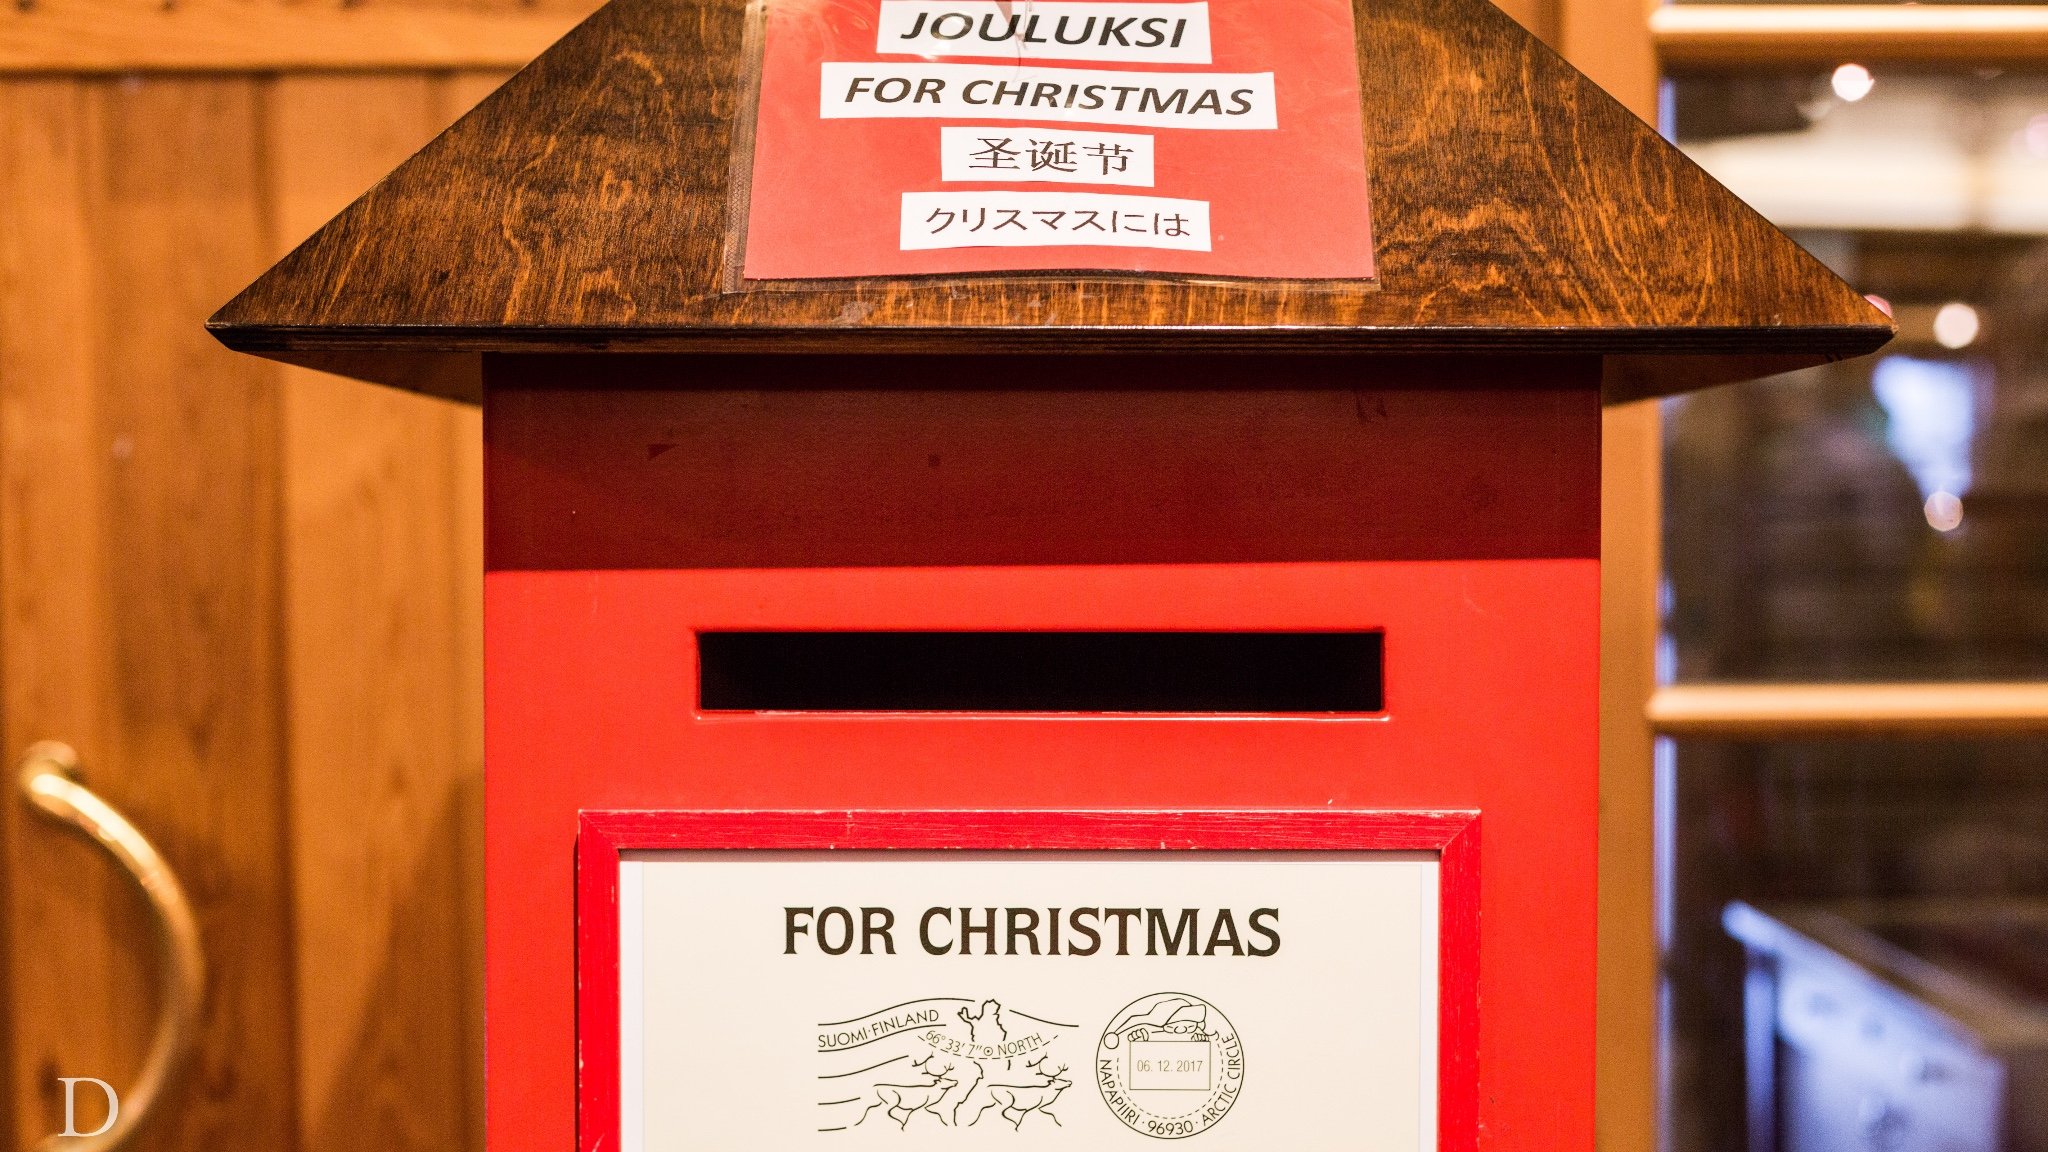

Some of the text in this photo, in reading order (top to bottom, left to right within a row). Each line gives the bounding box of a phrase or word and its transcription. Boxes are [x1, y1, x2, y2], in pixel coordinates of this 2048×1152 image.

[901, 11, 1187, 49] JOULUKSI
[844, 76, 1255, 116] FOR CHRISTMAS
[967, 137, 1135, 176] 圣诞节
[925, 206, 1191, 238] クリスマスには
[783, 906, 1282, 958] FOR CHRISTMAS
[997, 1032, 1043, 1056] NORTH
[1099, 1033, 1241, 1136] NAPAPIIRI 96930 ARCTIC CIRCLE
[1176, 1060, 1203, 1072] 2017
